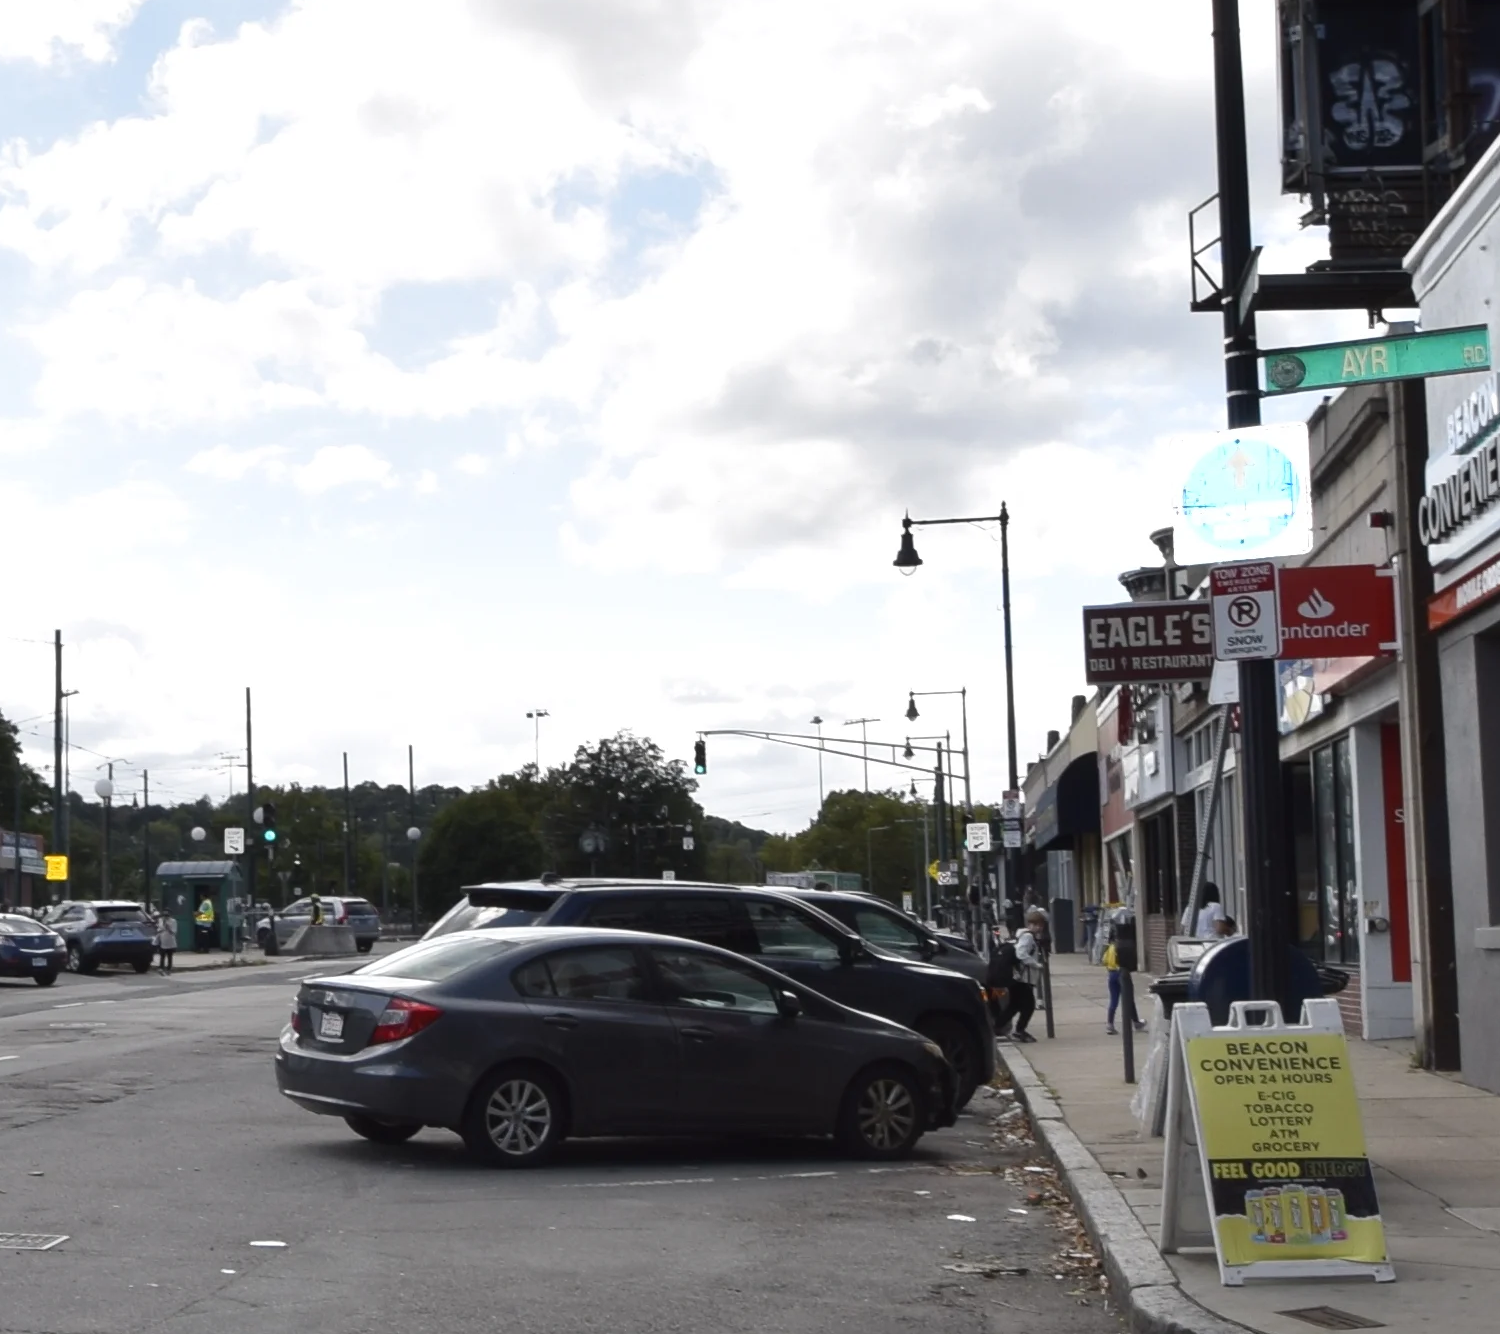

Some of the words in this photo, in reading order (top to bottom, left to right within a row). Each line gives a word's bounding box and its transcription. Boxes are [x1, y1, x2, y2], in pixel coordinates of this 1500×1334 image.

[1340, 345, 1391, 378] AYR
[1463, 344, 1486, 366] RD
[1213, 567, 1238, 580] TOW
[1240, 564, 1271, 577] ZONE
[1216, 576, 1268, 588] EMERGENCY
[1090, 610, 1211, 649] EAGLE'S
[1281, 620, 1371, 641] antander
[1227, 635, 1264, 647] SNOW
[1090, 659, 1115, 672] DELI
[1132, 653, 1215, 670] RESTAURANT
[1226, 1041, 1309, 1056] BEACON
[1200, 1056, 1342, 1072] CONVENIENCE
[1214, 1074, 1255, 1085] OPEN
[1259, 1074, 1277, 1084] 24
[1282, 1073, 1333, 1084] HOURS
[1257, 1091, 1296, 1101] E-CIG
[1244, 1104, 1314, 1114] TOBACCO
[1249, 1116, 1313, 1127] LOTTERY
[1269, 1129, 1299, 1139] ATM
[1252, 1142, 1320, 1152] GROCERY
[1212, 1162, 1249, 1179] FEEL
[1251, 1162, 1301, 1178] GOOD
[1305, 1160, 1367, 1177] ENERGY
